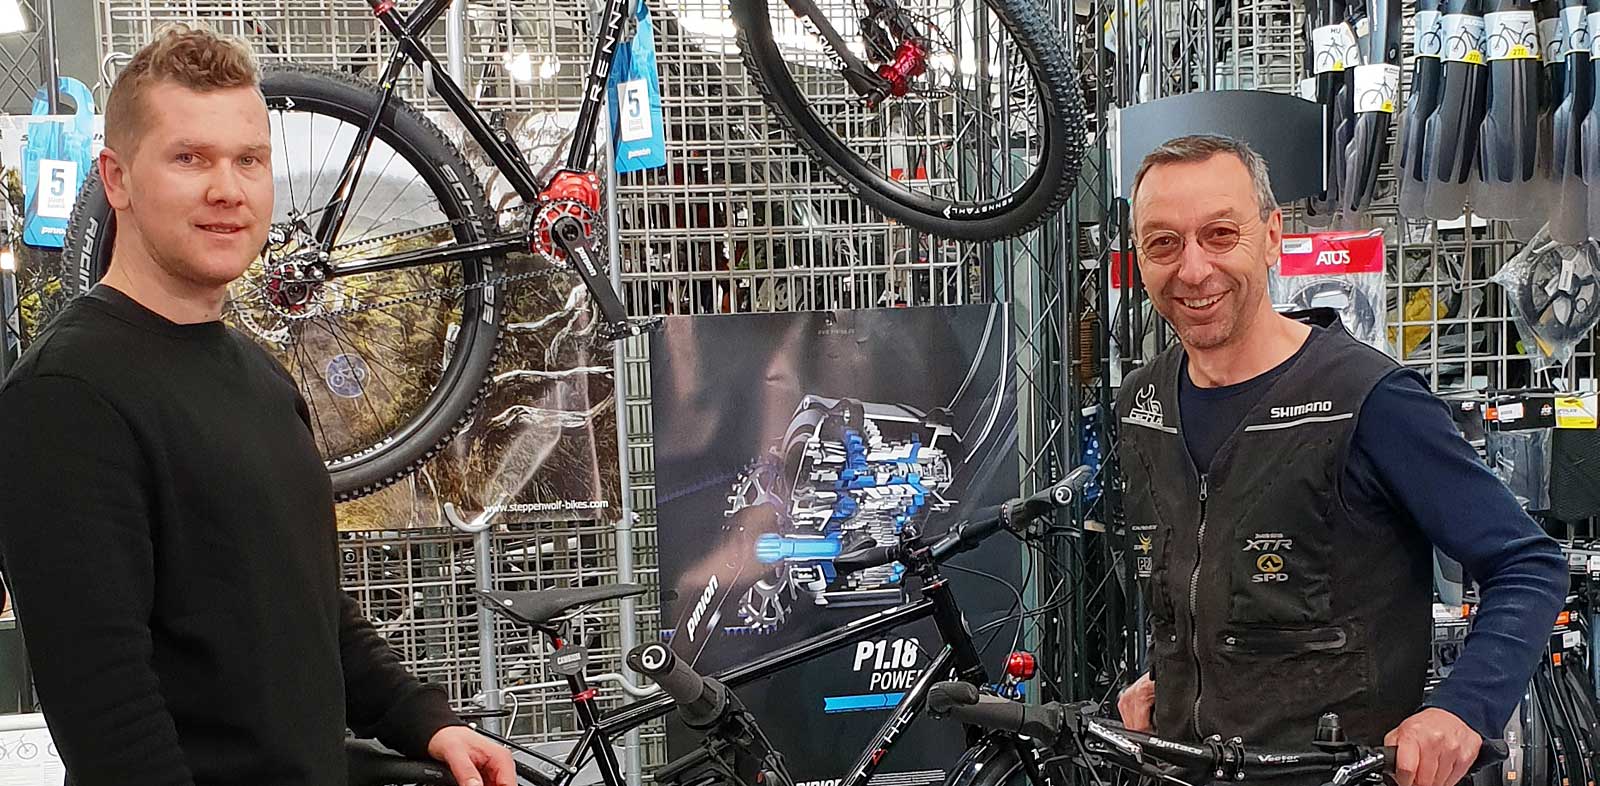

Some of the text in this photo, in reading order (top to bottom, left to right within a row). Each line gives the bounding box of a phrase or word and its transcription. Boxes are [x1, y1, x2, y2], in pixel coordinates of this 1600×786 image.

[590, 0, 625, 102] RENN
[819, 34, 848, 72] SWISS
[628, 89, 641, 118] 5
[50, 168, 65, 196] 5
[79, 216, 99, 297] RACIN
[1270, 401, 1332, 419] SHIMANO
[484, 500, 609, 514] www.steppenwolf-bikes.com
[1241, 539, 1293, 552] XTR
[1251, 573, 1289, 583] SPD
[686, 574, 719, 642] pinion
[853, 637, 920, 672] P1.18
[1148, 737, 1204, 755] Syntace
